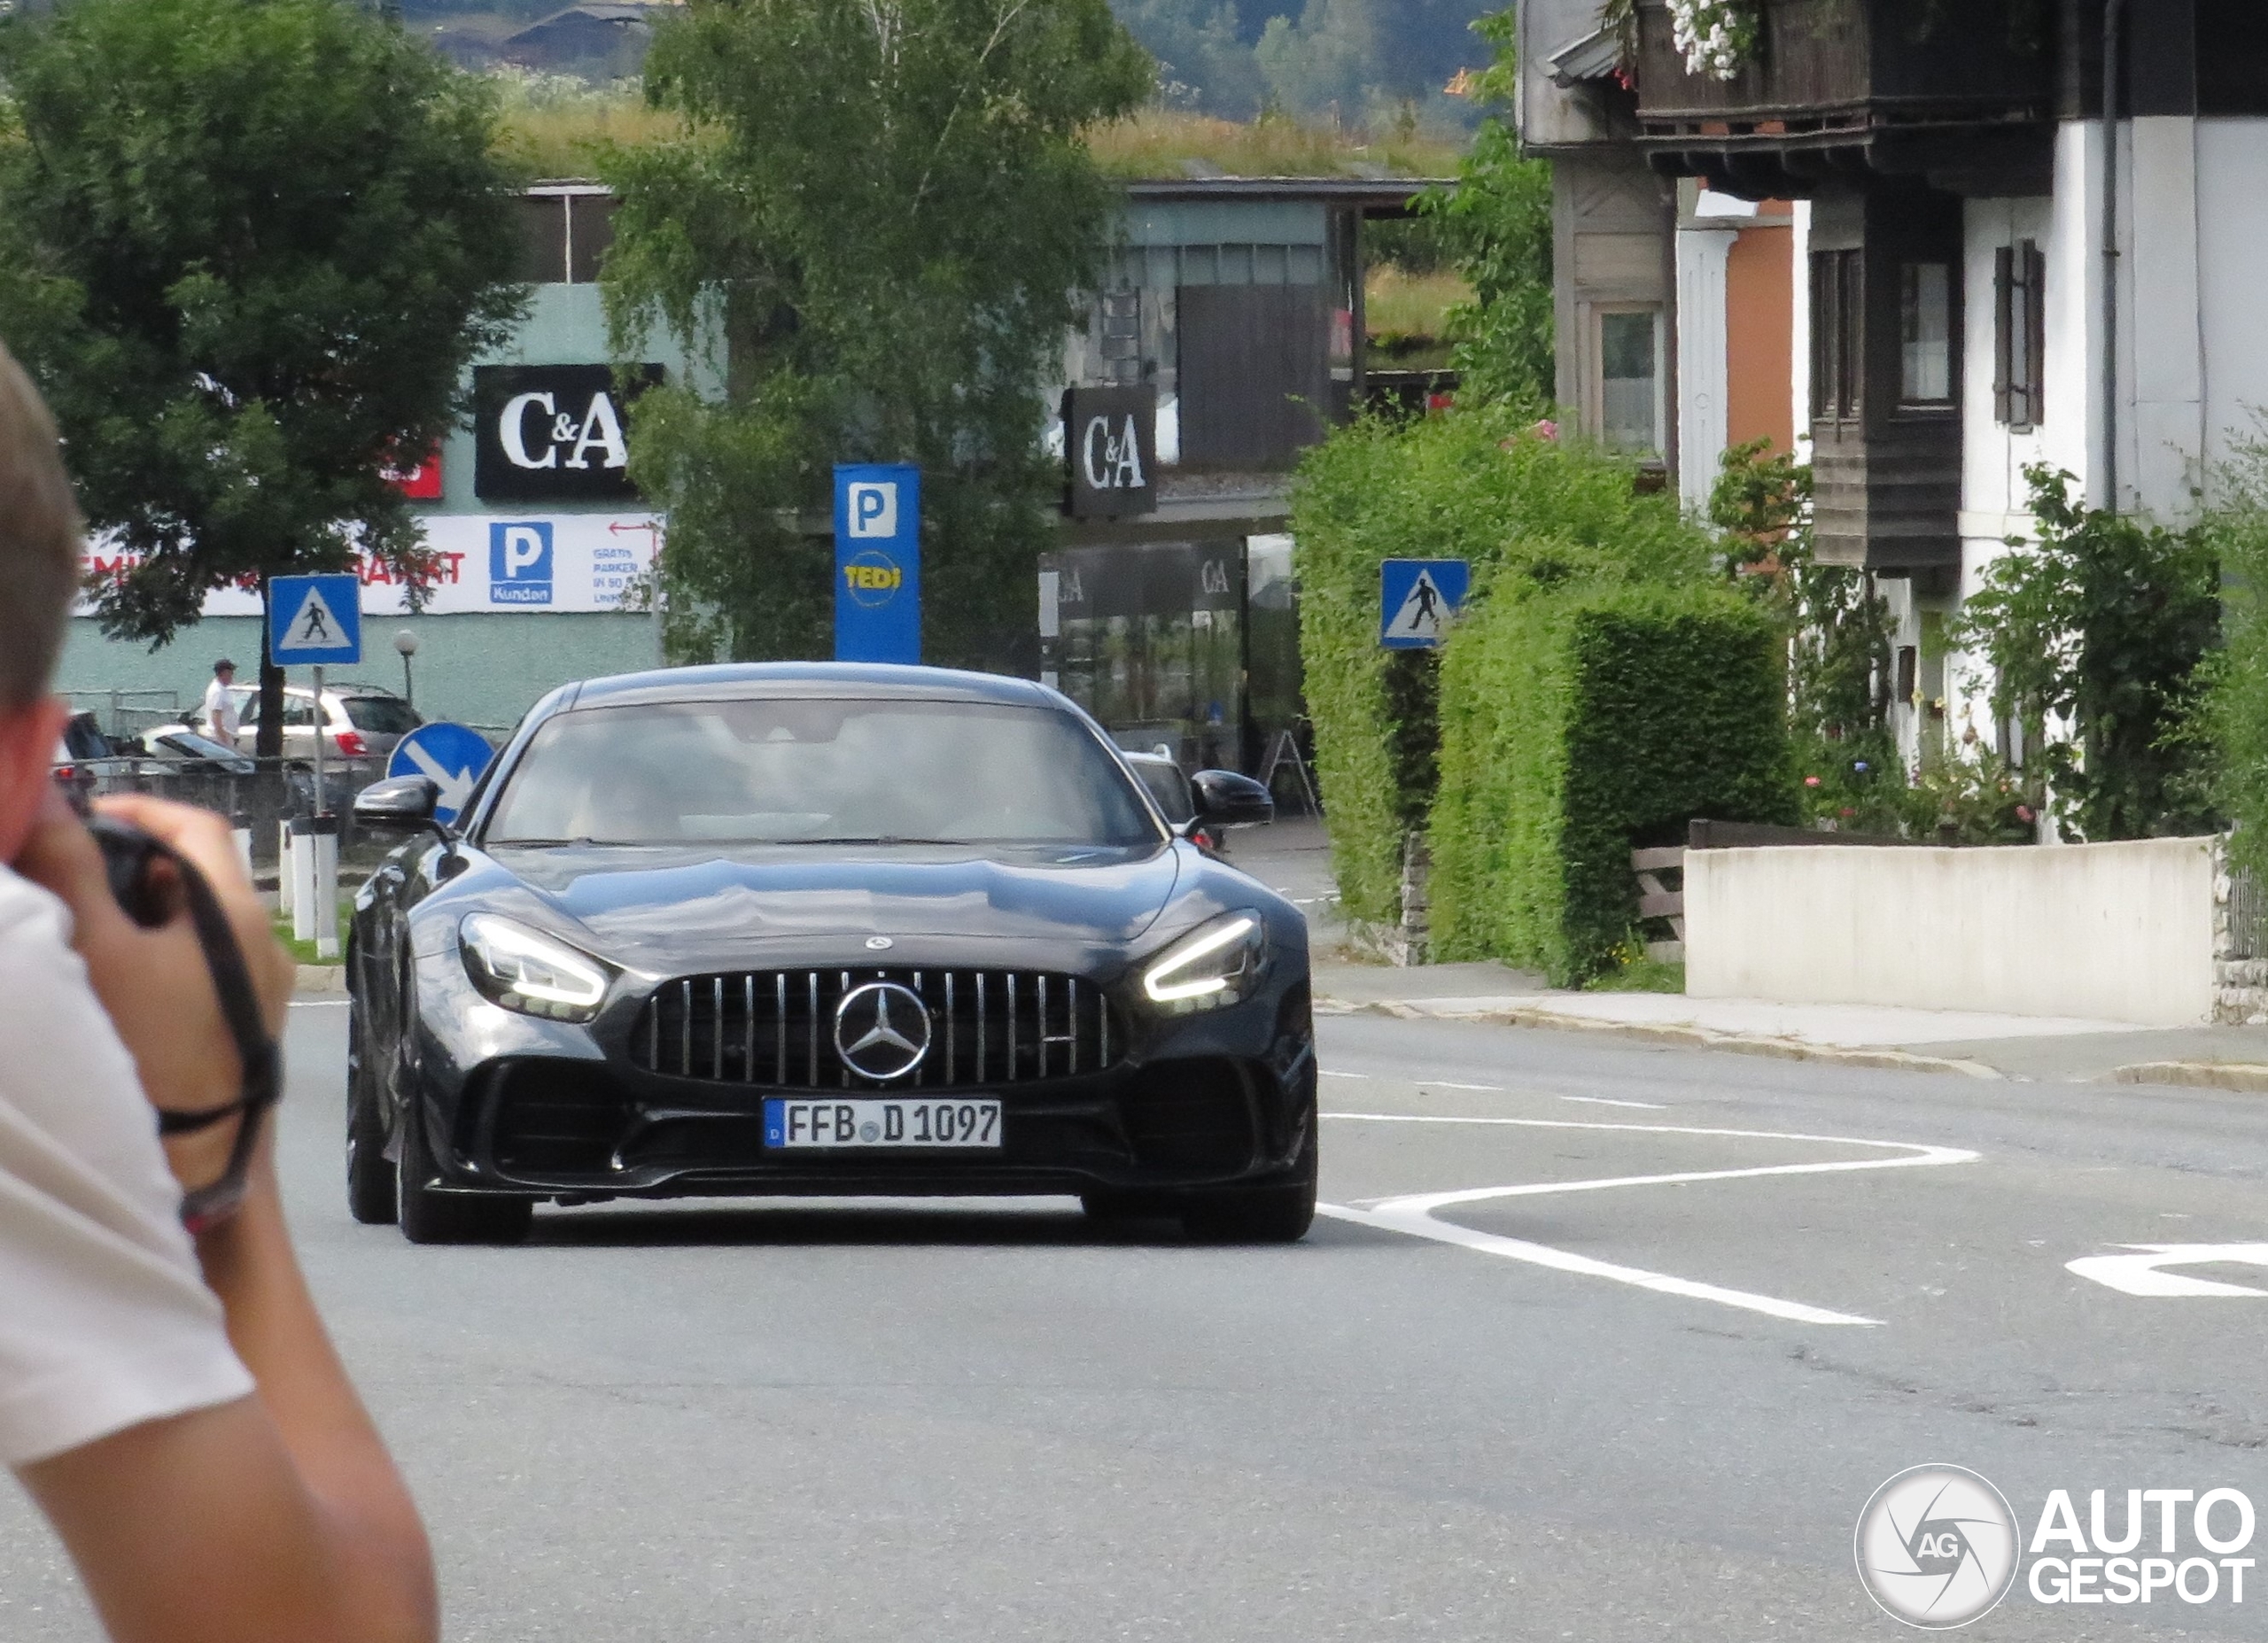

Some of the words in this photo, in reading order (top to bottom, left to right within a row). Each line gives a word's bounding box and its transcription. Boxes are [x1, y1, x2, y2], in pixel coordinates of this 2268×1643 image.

[500, 391, 628, 469] C&A
[1084, 414, 1146, 488] C&A
[858, 490, 884, 531] P
[505, 526, 542, 577] P
[593, 549, 633, 559] GRATIS
[342, 553, 465, 585] AKT
[493, 587, 548, 601] Kunden
[594, 593, 622, 603] LINK
[770, 1128, 780, 1140] D
[788, 1105, 856, 1141] FFB
[884, 1105, 904, 1141] D
[913, 1105, 998, 1141] 1097
